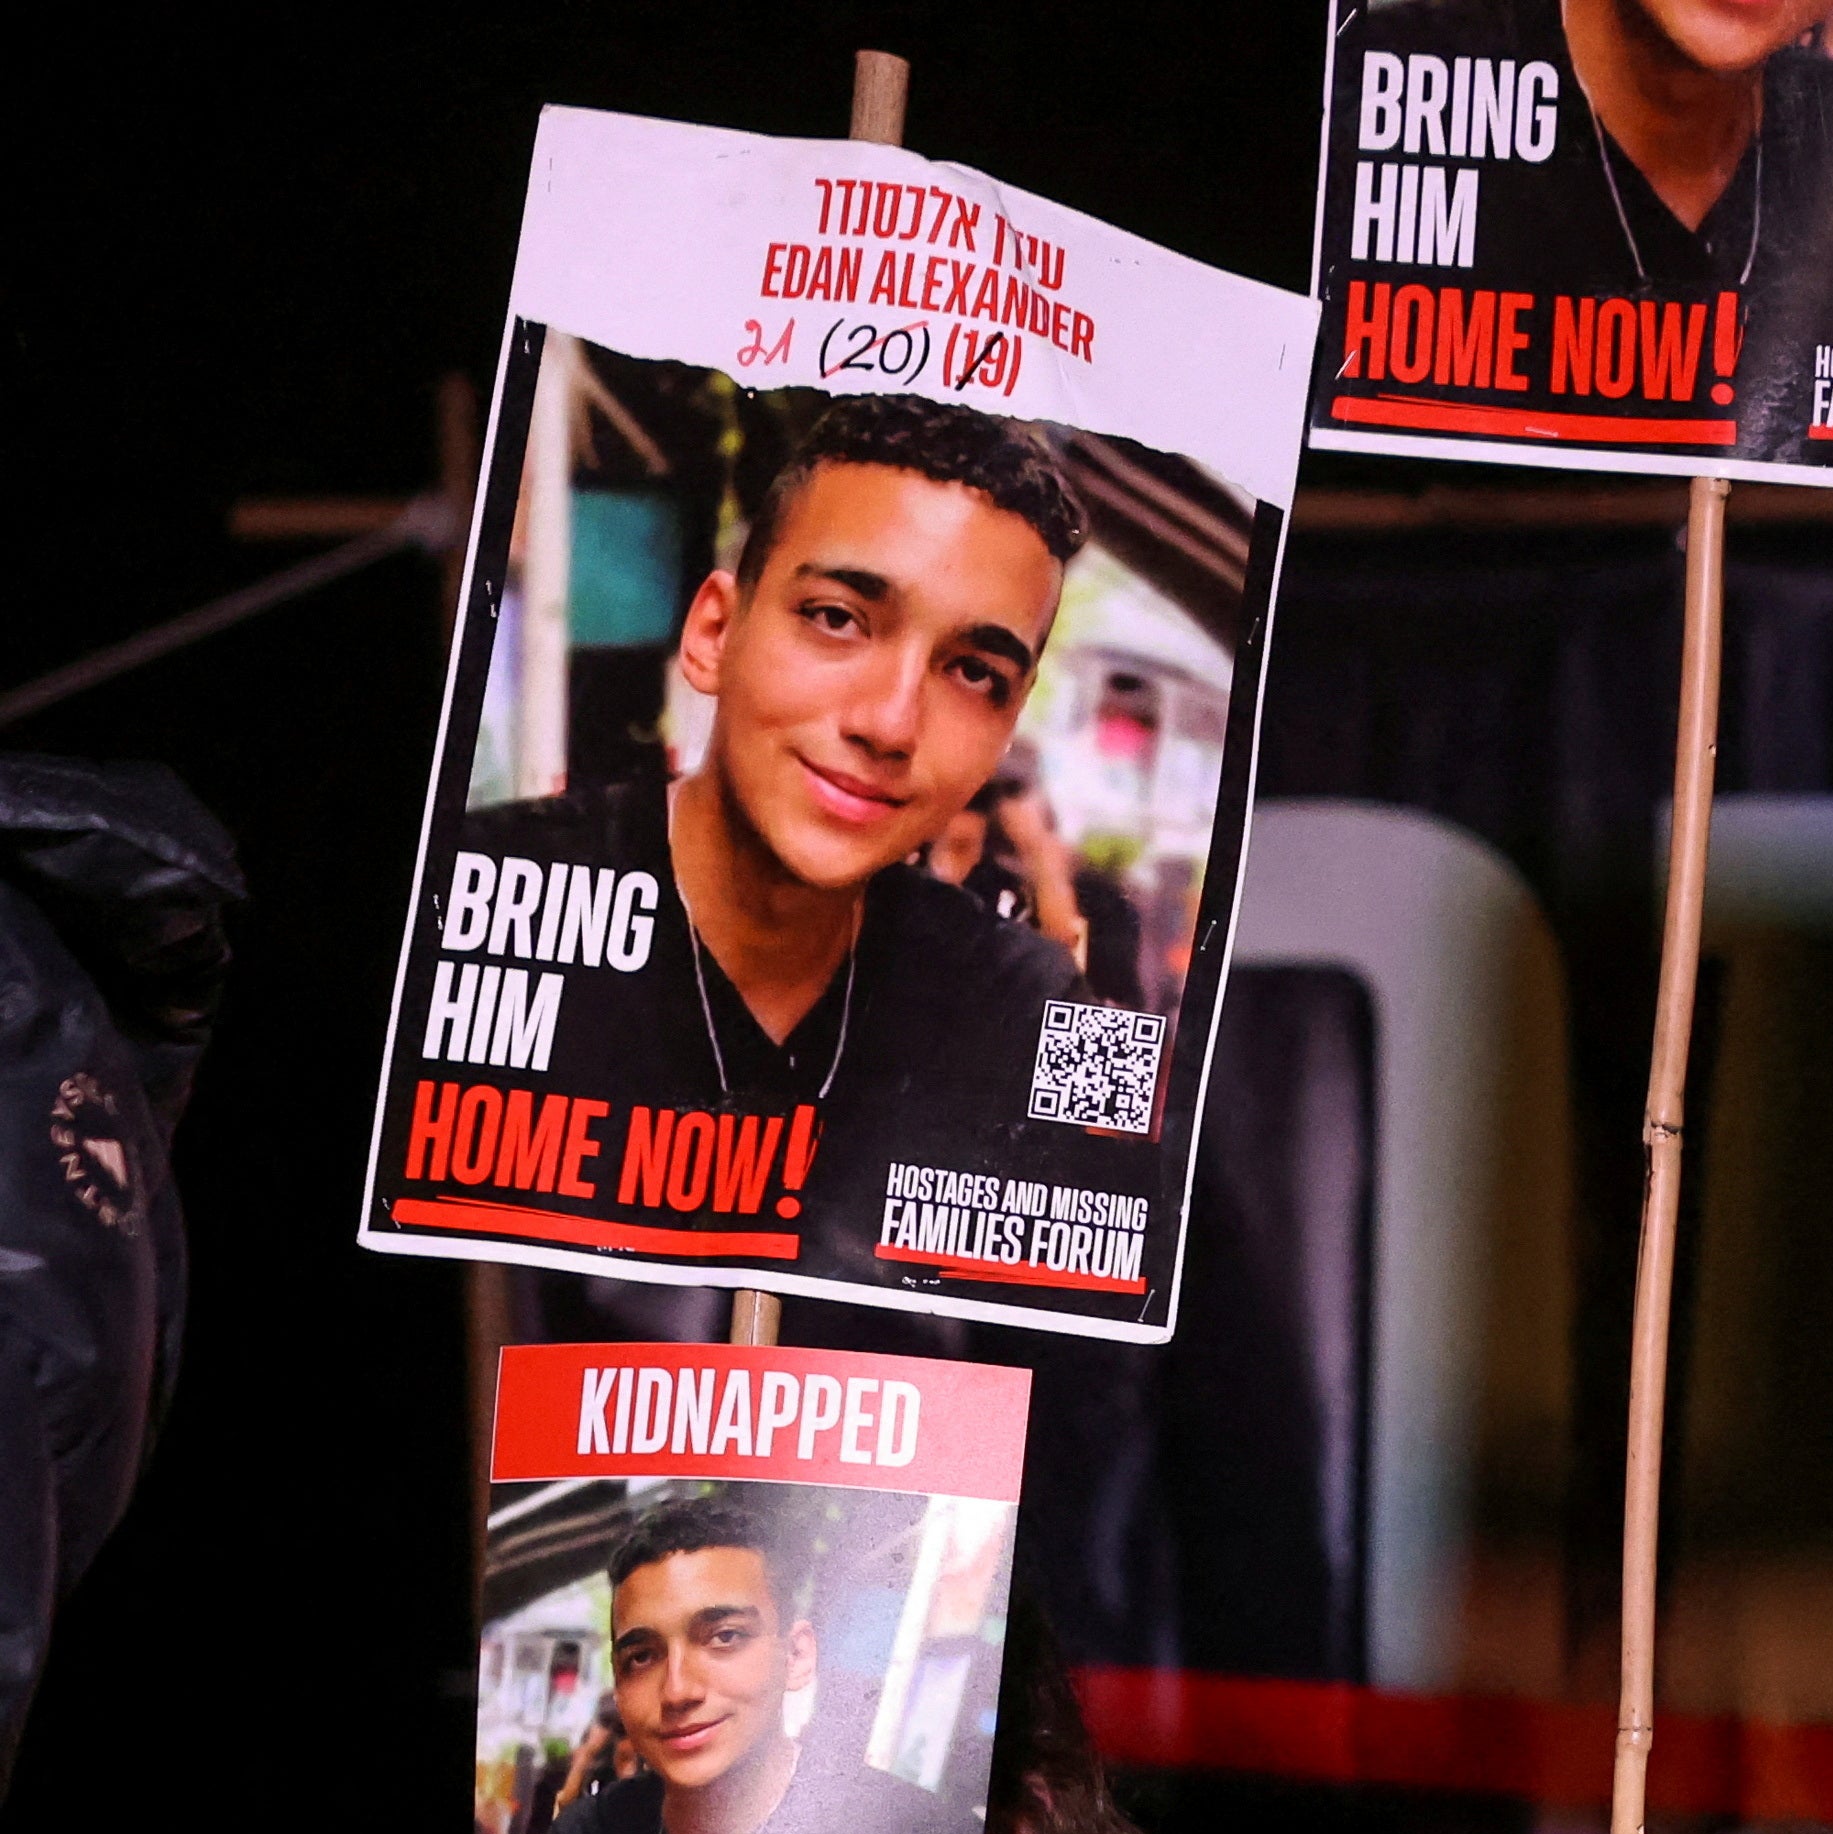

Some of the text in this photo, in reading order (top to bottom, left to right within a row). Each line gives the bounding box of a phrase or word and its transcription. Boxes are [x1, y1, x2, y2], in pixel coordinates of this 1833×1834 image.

[1358, 50, 1558, 163] BRING
[815, 179, 1065, 291] עידן אלכסנדר
[1351, 162, 1479, 268] HIM
[761, 243, 1094, 364] EDAN ALEXANDER
[819, 318, 930, 386] (20)
[1343, 281, 1746, 405] HOME NOW!
[441, 851, 659, 972] BRING
[422, 960, 564, 1071] HIM
[405, 1080, 824, 1220] HOME NOW!
[886, 1162, 1148, 1231] HOSTAGES AND MISSING
[881, 1199, 1144, 1282] FAMILIES FORUM
[576, 1367, 920, 1468] KIDNAPPED
